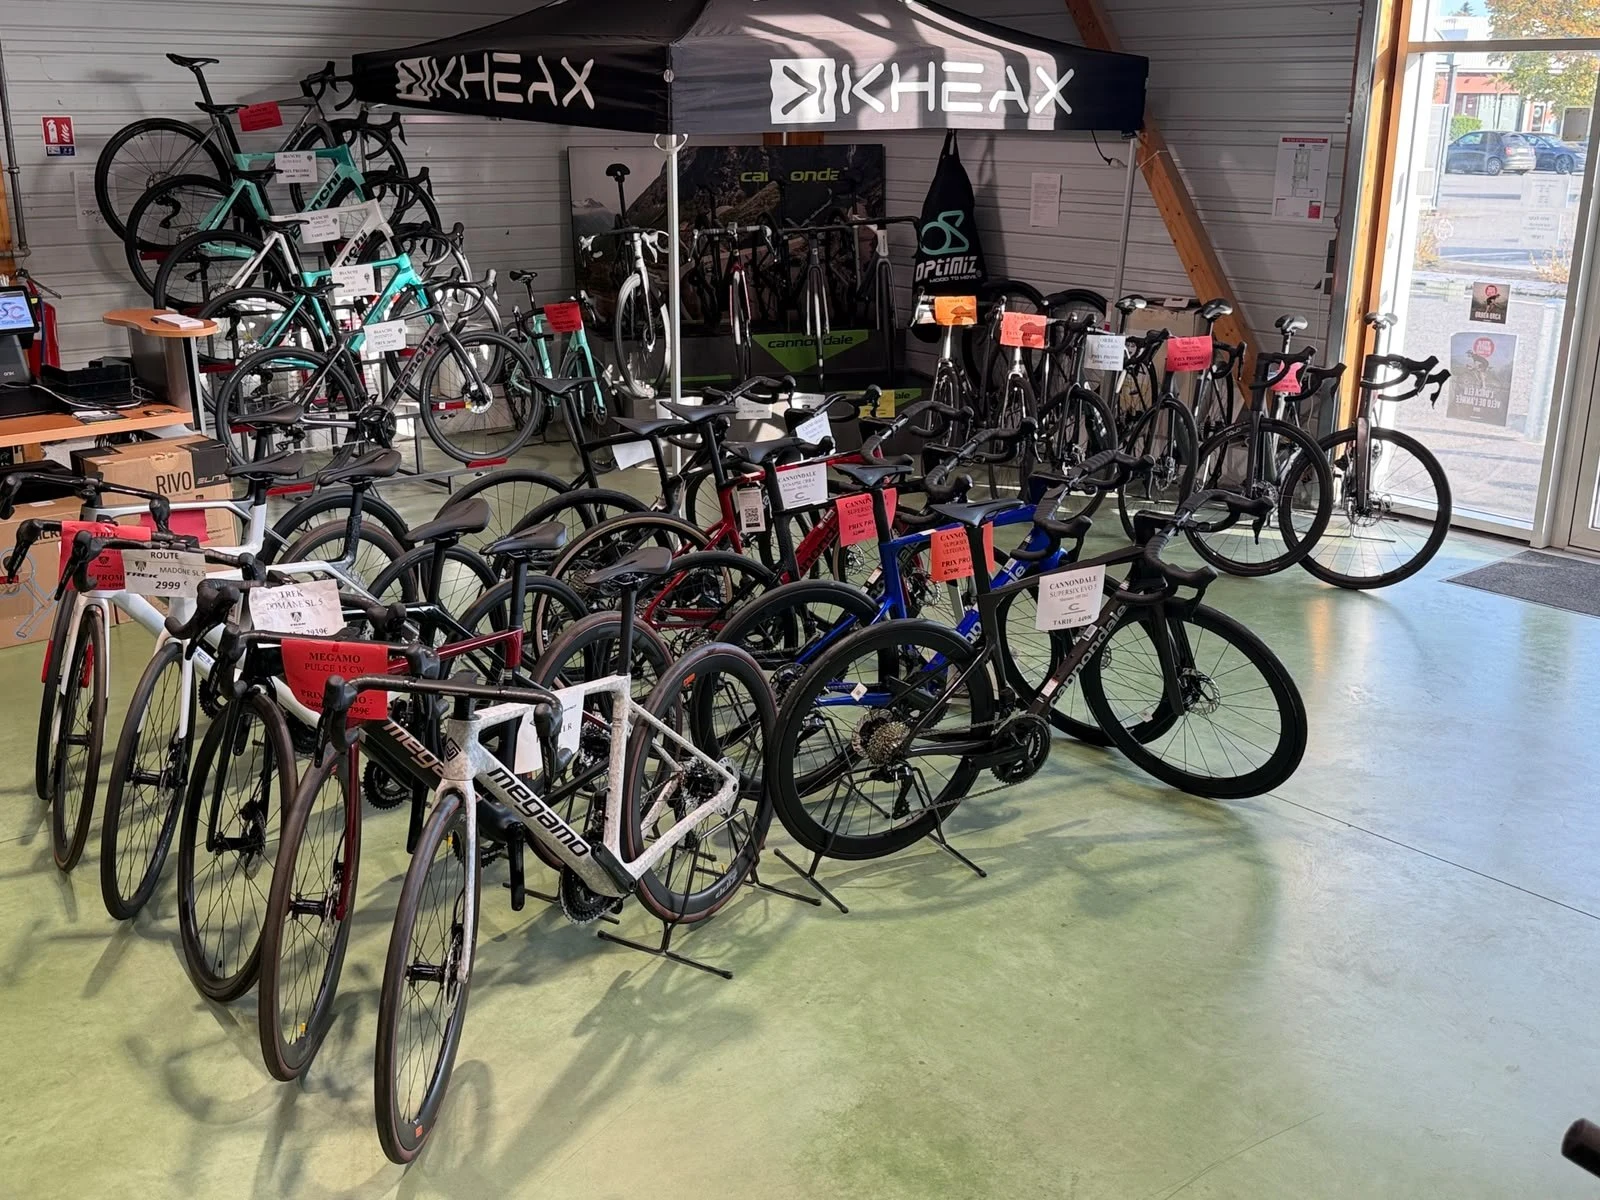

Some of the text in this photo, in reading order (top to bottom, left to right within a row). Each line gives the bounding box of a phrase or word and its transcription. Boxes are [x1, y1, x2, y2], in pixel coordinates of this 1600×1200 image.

[431, 51, 595, 110] KHEAX
[841, 61, 1075, 115] KHEAX
[767, 335, 854, 349] cannodale
[155, 471, 192, 495] RIVO
[778, 471, 817, 482] CANNONDALE
[150, 552, 180, 560] ROUTE
[159, 567, 191, 575] MADONE
[155, 581, 181, 589] 2999
[1049, 575, 1098, 590] CANNONDALE
[280, 589, 304, 598] TREK
[1049, 588, 1079, 598] SUPERSIX
[1079, 585, 1093, 594] EVO
[265, 599, 304, 611] DOMANE
[308, 652, 361, 664] MEGAMO
[1049, 604, 1128, 709] cannondale
[304, 663, 335, 673] PULCE
[338, 665, 348, 673] 15
[383, 722, 445, 777] mega
[487, 767, 591, 858] megamo
